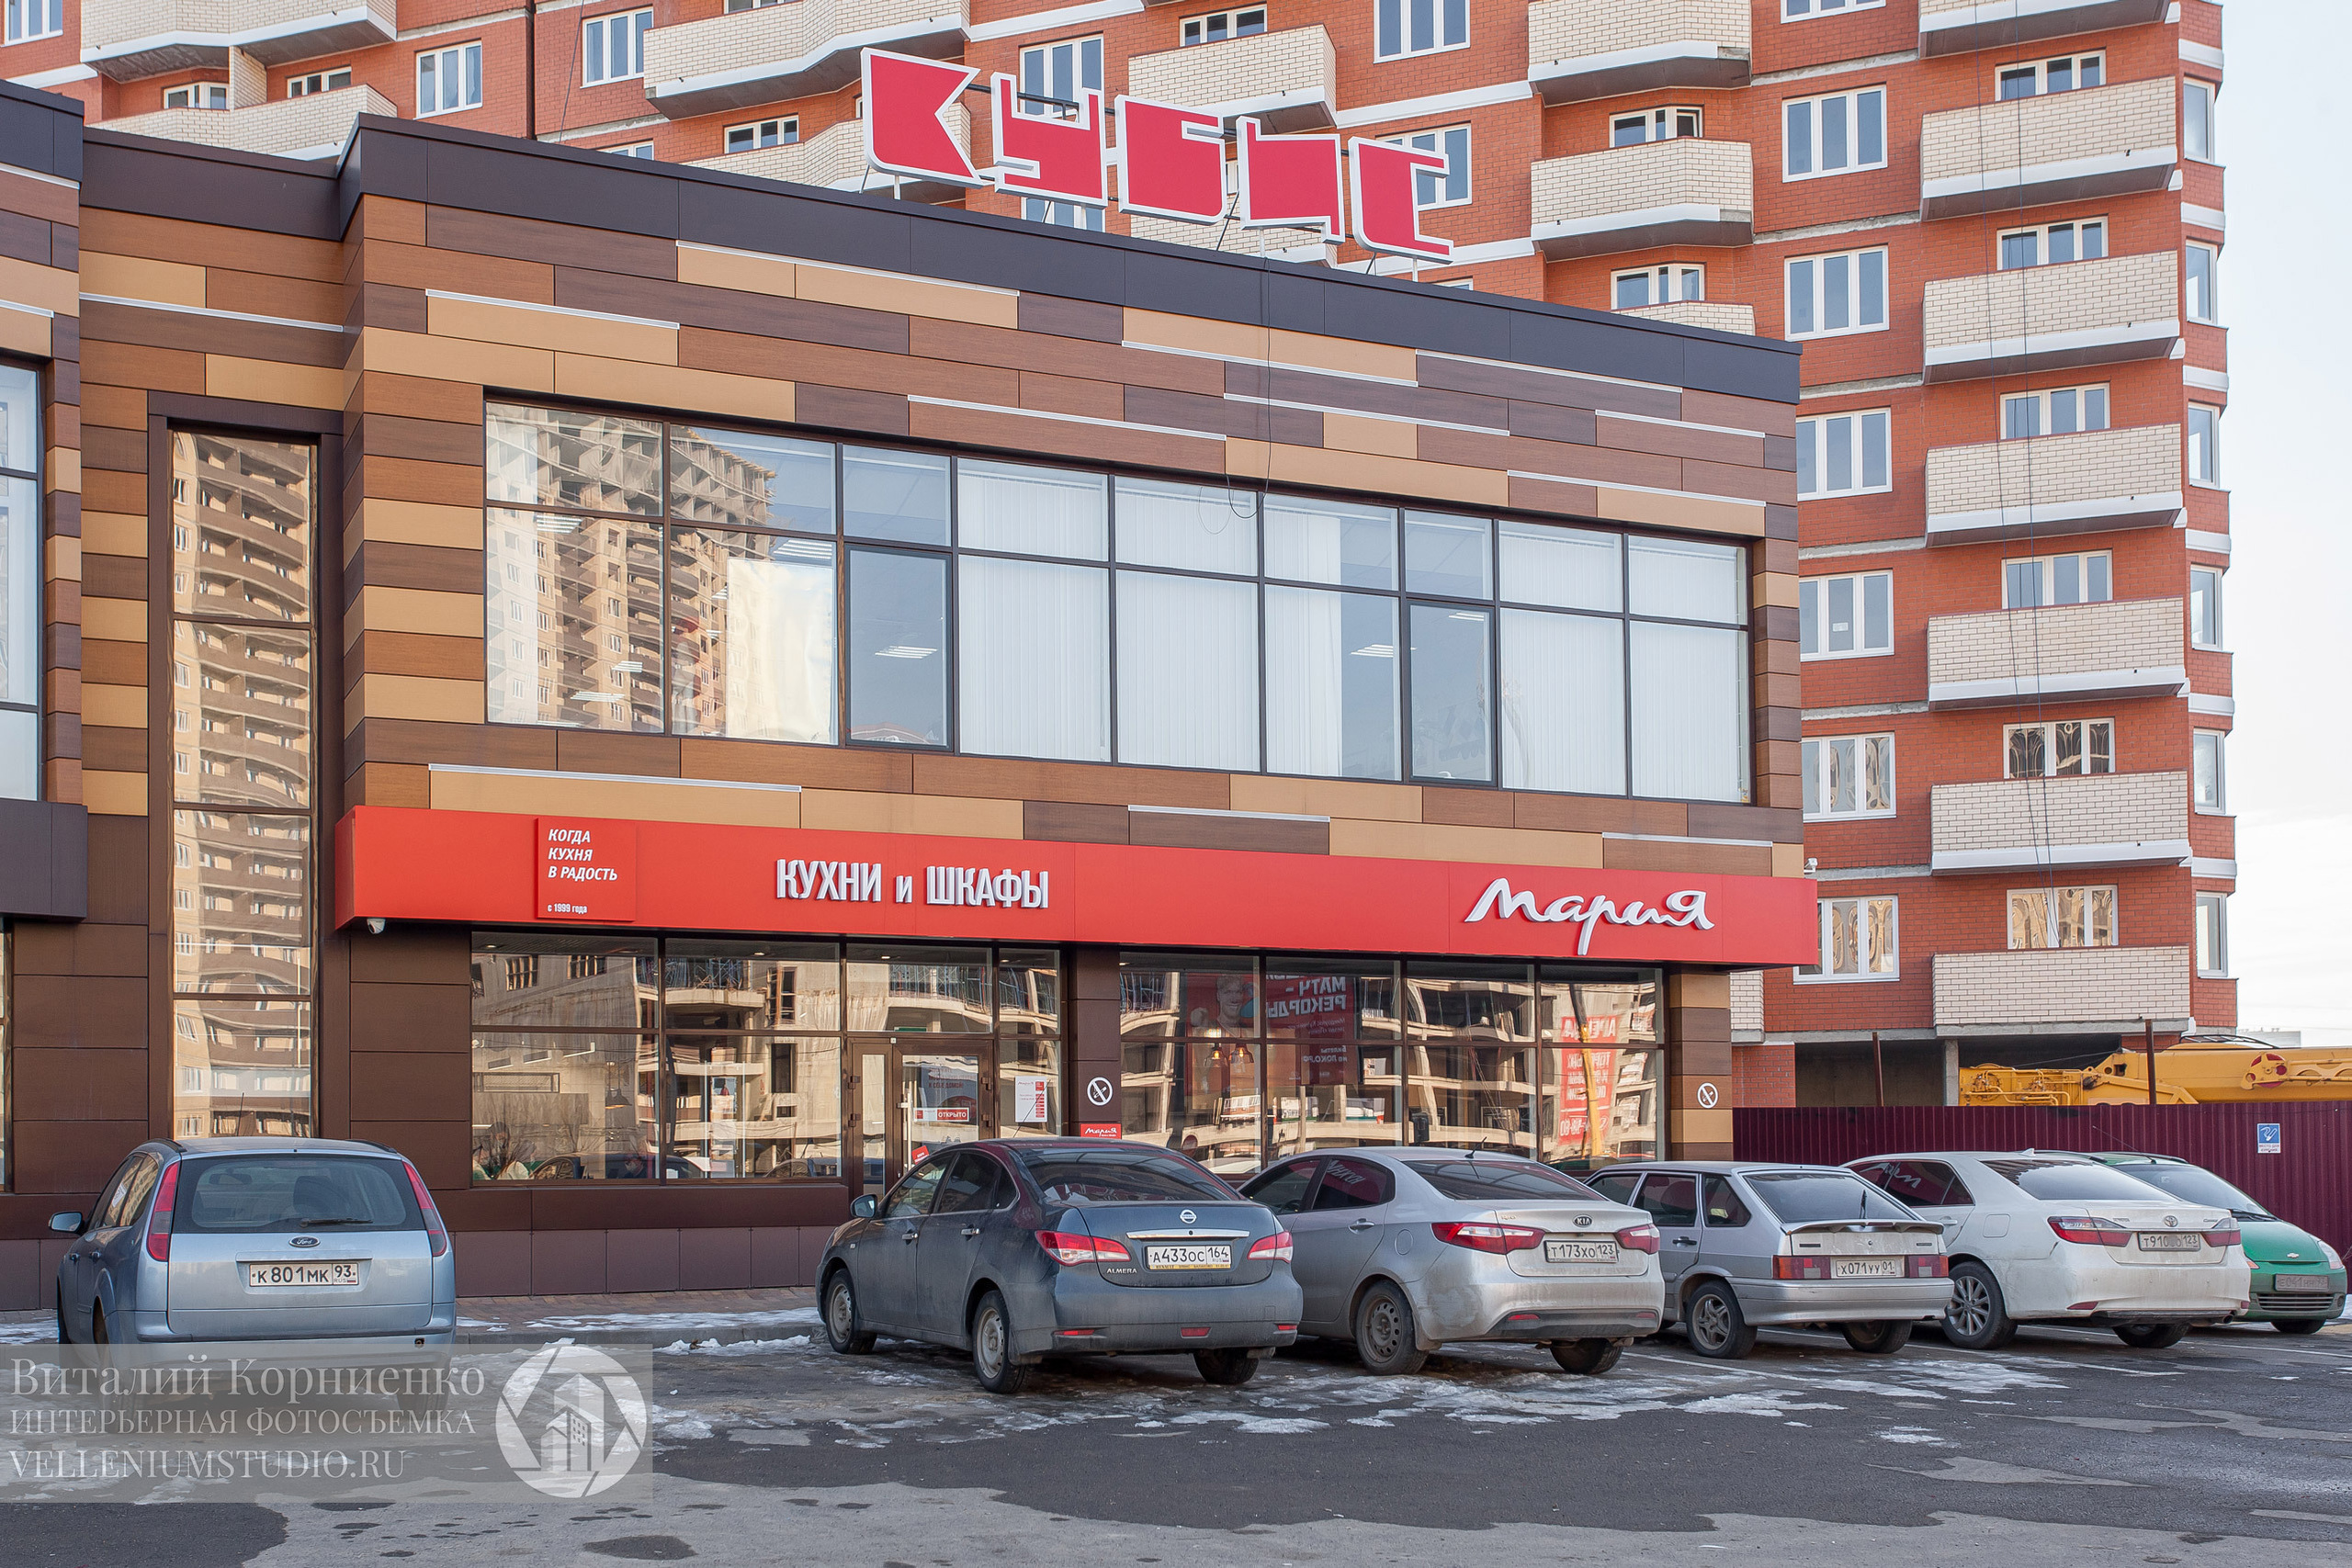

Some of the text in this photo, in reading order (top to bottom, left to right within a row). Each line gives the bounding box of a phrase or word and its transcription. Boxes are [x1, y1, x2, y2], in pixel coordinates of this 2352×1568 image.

[548, 829, 591, 845] КОГДА
[548, 847, 594, 862] КУХНЯ
[548, 865, 618, 882] В РАДОСТЬ
[775, 858, 1049, 908] КУХНИ и ШКАФЫ
[553, 903, 571, 913] 1999
[571, 905, 588, 915] года
[1577, 1217, 1591, 1225] KIA
[1207, 1247, 1229, 1258] 164
[334, 1265, 352, 1278] 93
